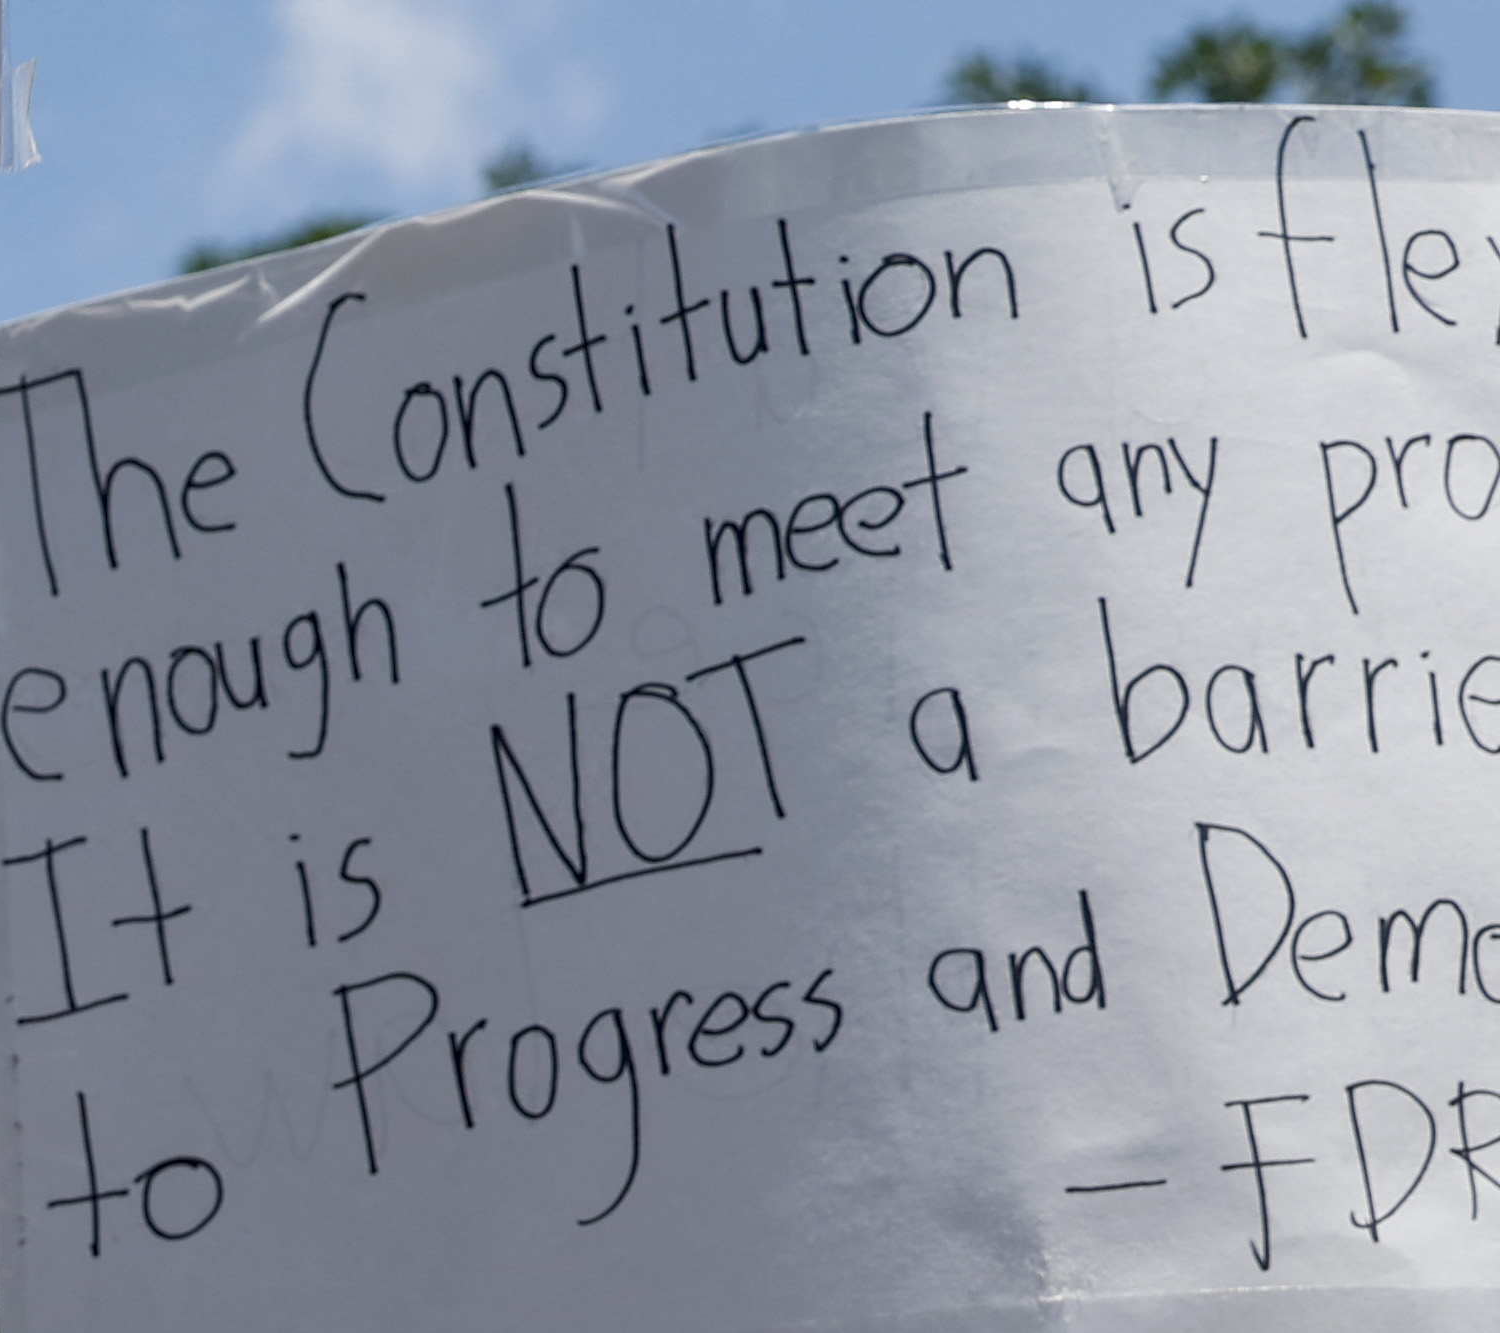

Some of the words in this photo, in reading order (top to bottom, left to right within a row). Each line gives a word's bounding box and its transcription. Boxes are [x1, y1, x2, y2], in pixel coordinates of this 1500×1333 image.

[303, 218, 1019, 503] Constitution
[1118, 203, 1216, 314] is
[2, 562, 399, 780] enough
[481, 482, 605, 668] to
[704, 411, 968, 605] meet
[1057, 436, 1218, 588] any
[1320, 432, 1500, 615] pro
[2, 827, 191, 1025] It
[290, 834, 382, 948] is
[491, 637, 805, 897] NOT
[909, 686, 979, 781] a
[47, 1092, 224, 1258] to
[332, 970, 843, 1226] Progress
[928, 889, 1106, 1031] and
